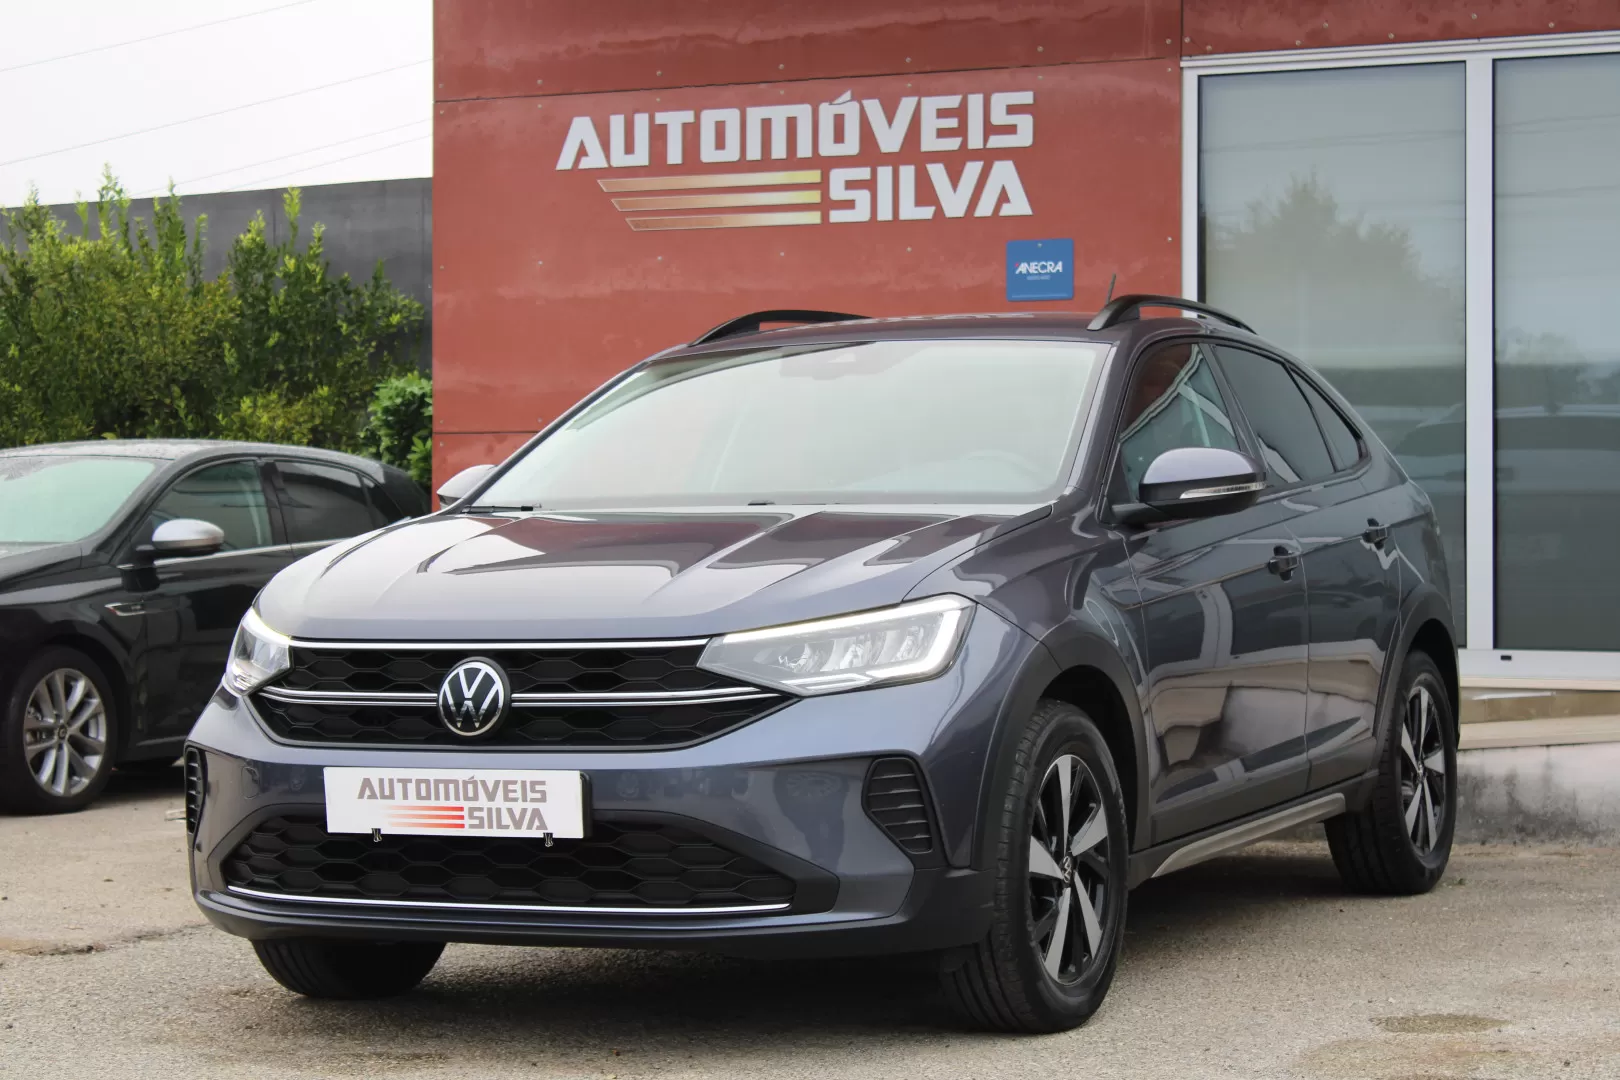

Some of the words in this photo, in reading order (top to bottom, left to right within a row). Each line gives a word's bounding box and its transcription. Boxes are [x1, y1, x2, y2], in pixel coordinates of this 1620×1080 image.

[555, 90, 1034, 171] AUTOMÓVEIS
[829, 160, 1034, 223] SILVA
[1015, 261, 1063, 274] ANECRA
[357, 775, 548, 803] AUTOMÓVEIS
[467, 806, 549, 831] SILVA
